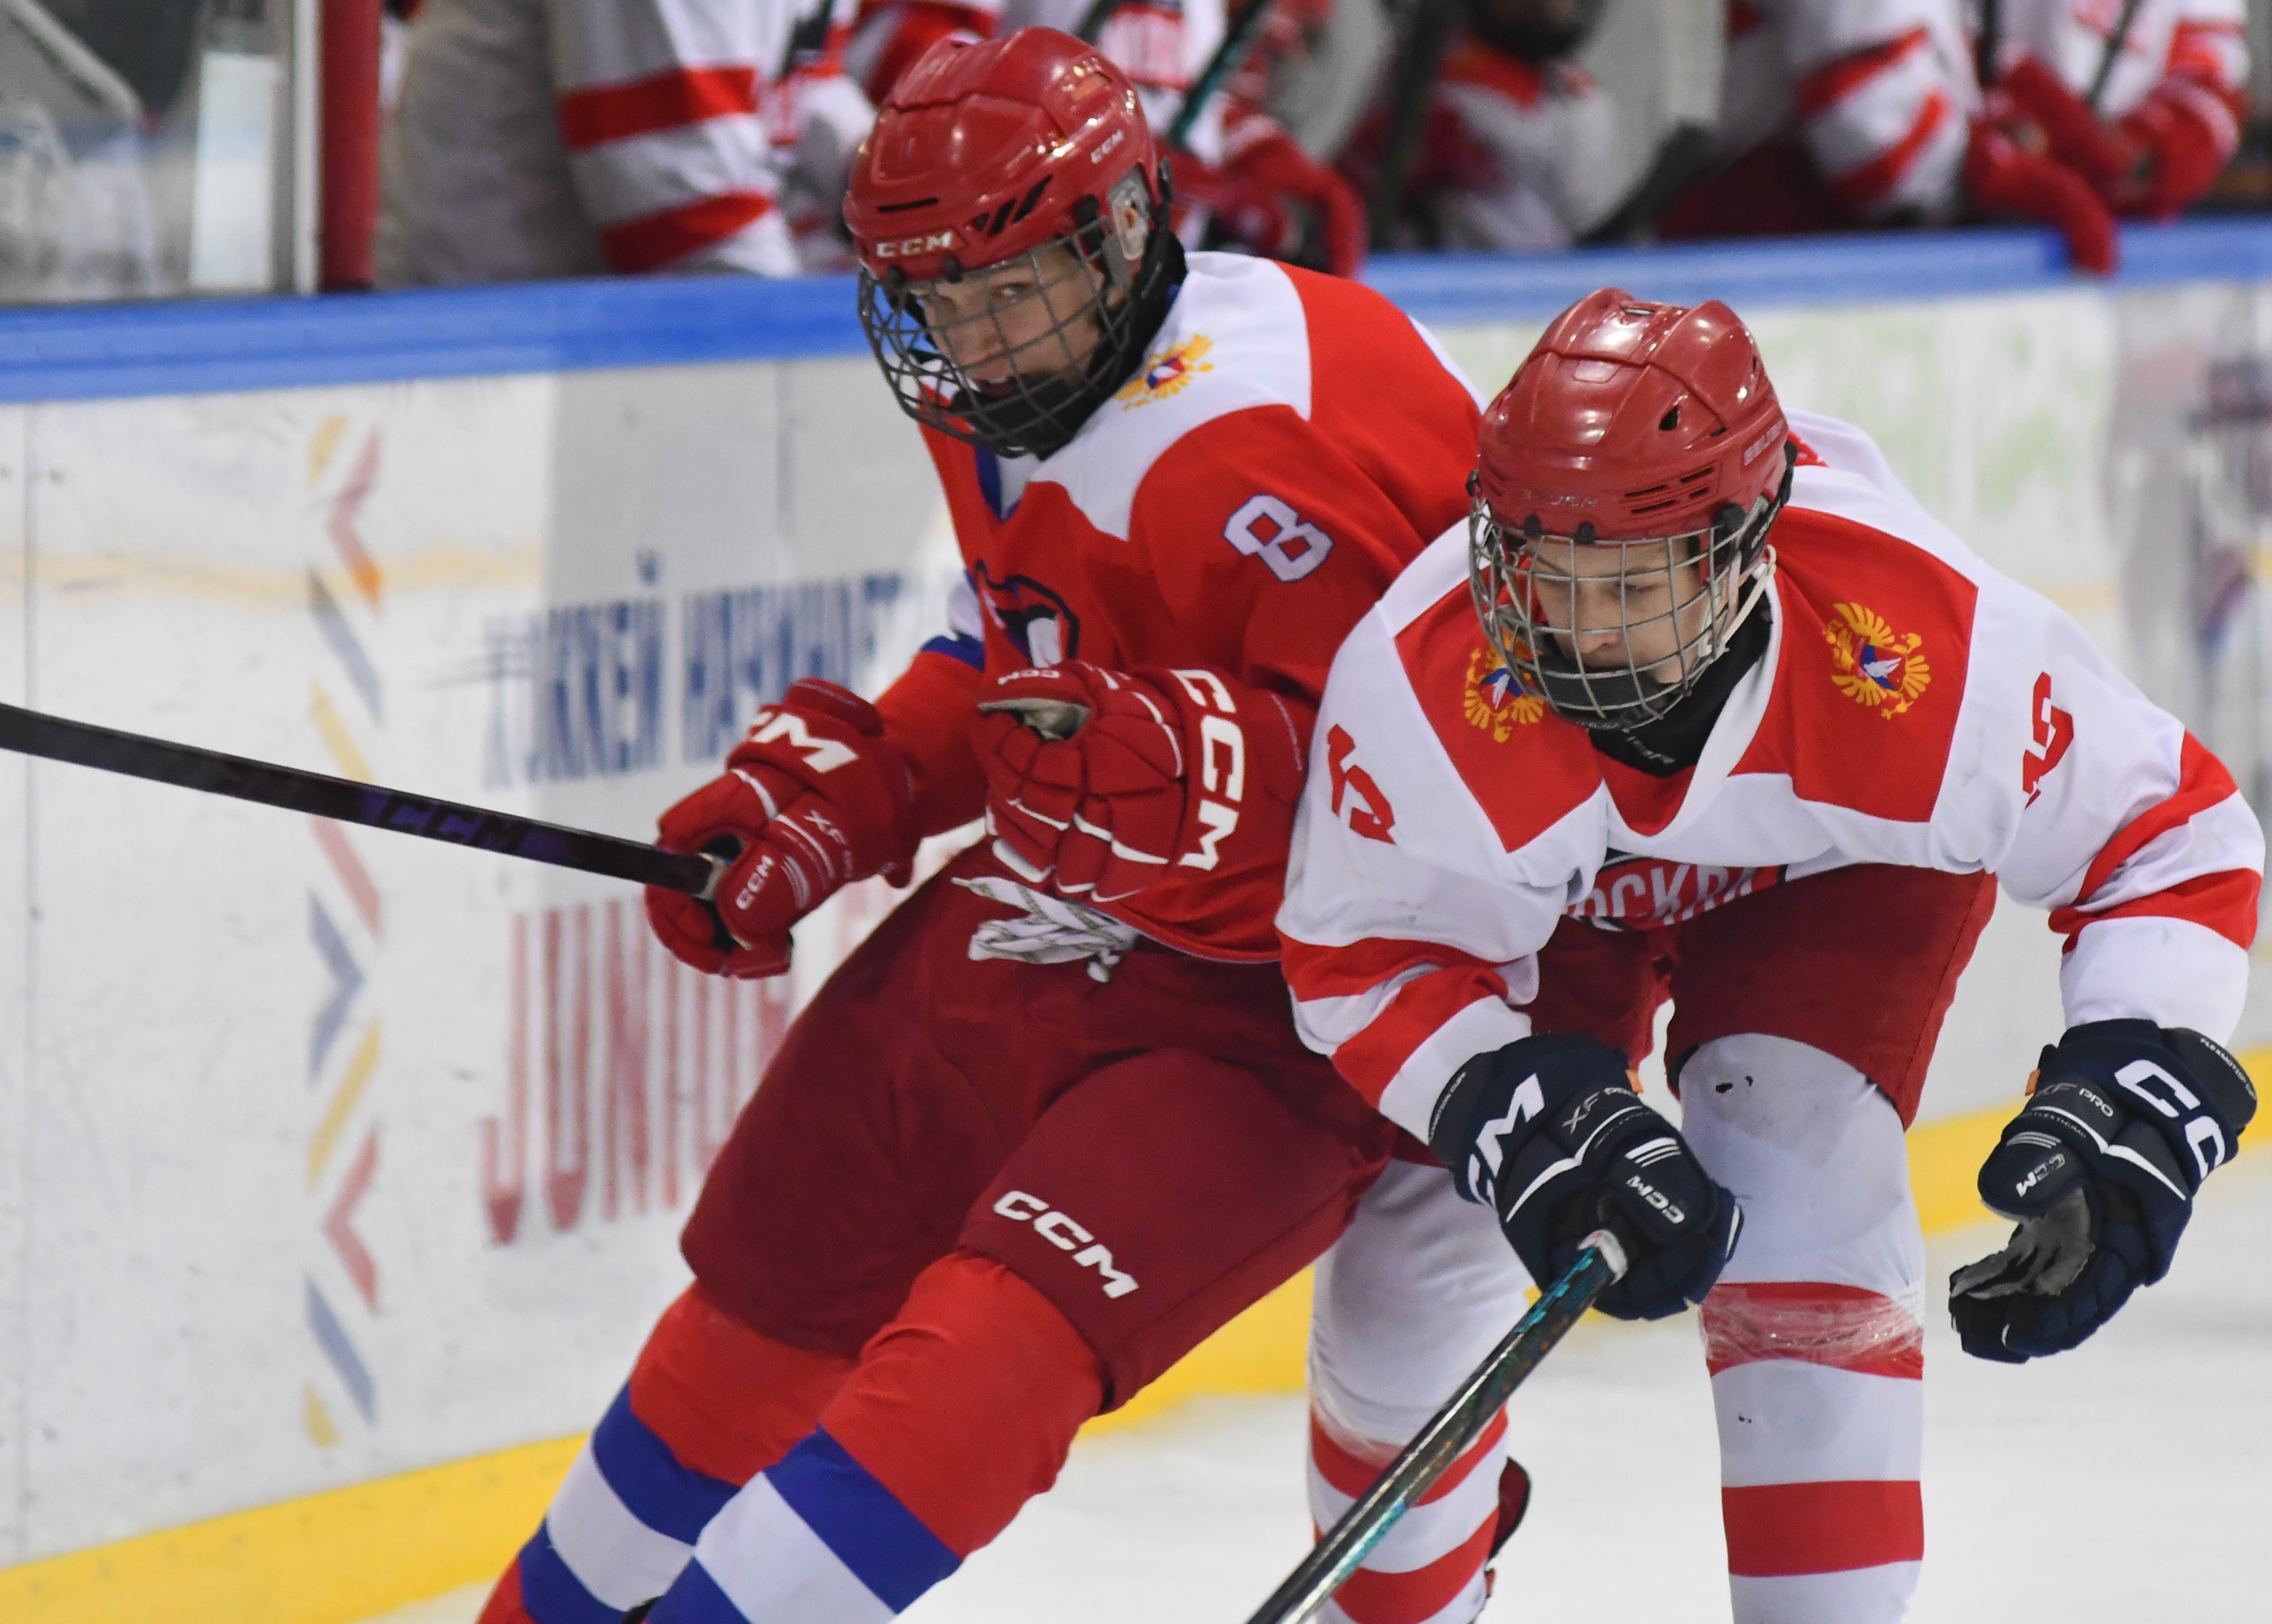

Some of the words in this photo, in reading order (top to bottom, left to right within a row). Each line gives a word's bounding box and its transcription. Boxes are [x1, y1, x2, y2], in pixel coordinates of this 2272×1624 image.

[876, 231, 952, 258] CCM
[1222, 493, 1335, 582] 8
[1170, 669, 1245, 871] CCM
[736, 855, 774, 910] CCM
[2079, 1087, 2114, 1117] PRO
[2114, 1059, 2226, 1180] CC
[1468, 1073, 1545, 1210] CM
[2015, 1153, 2066, 1198] CCM
[1626, 1175, 1686, 1225] CCM
[993, 1190, 1140, 1299] CCM
